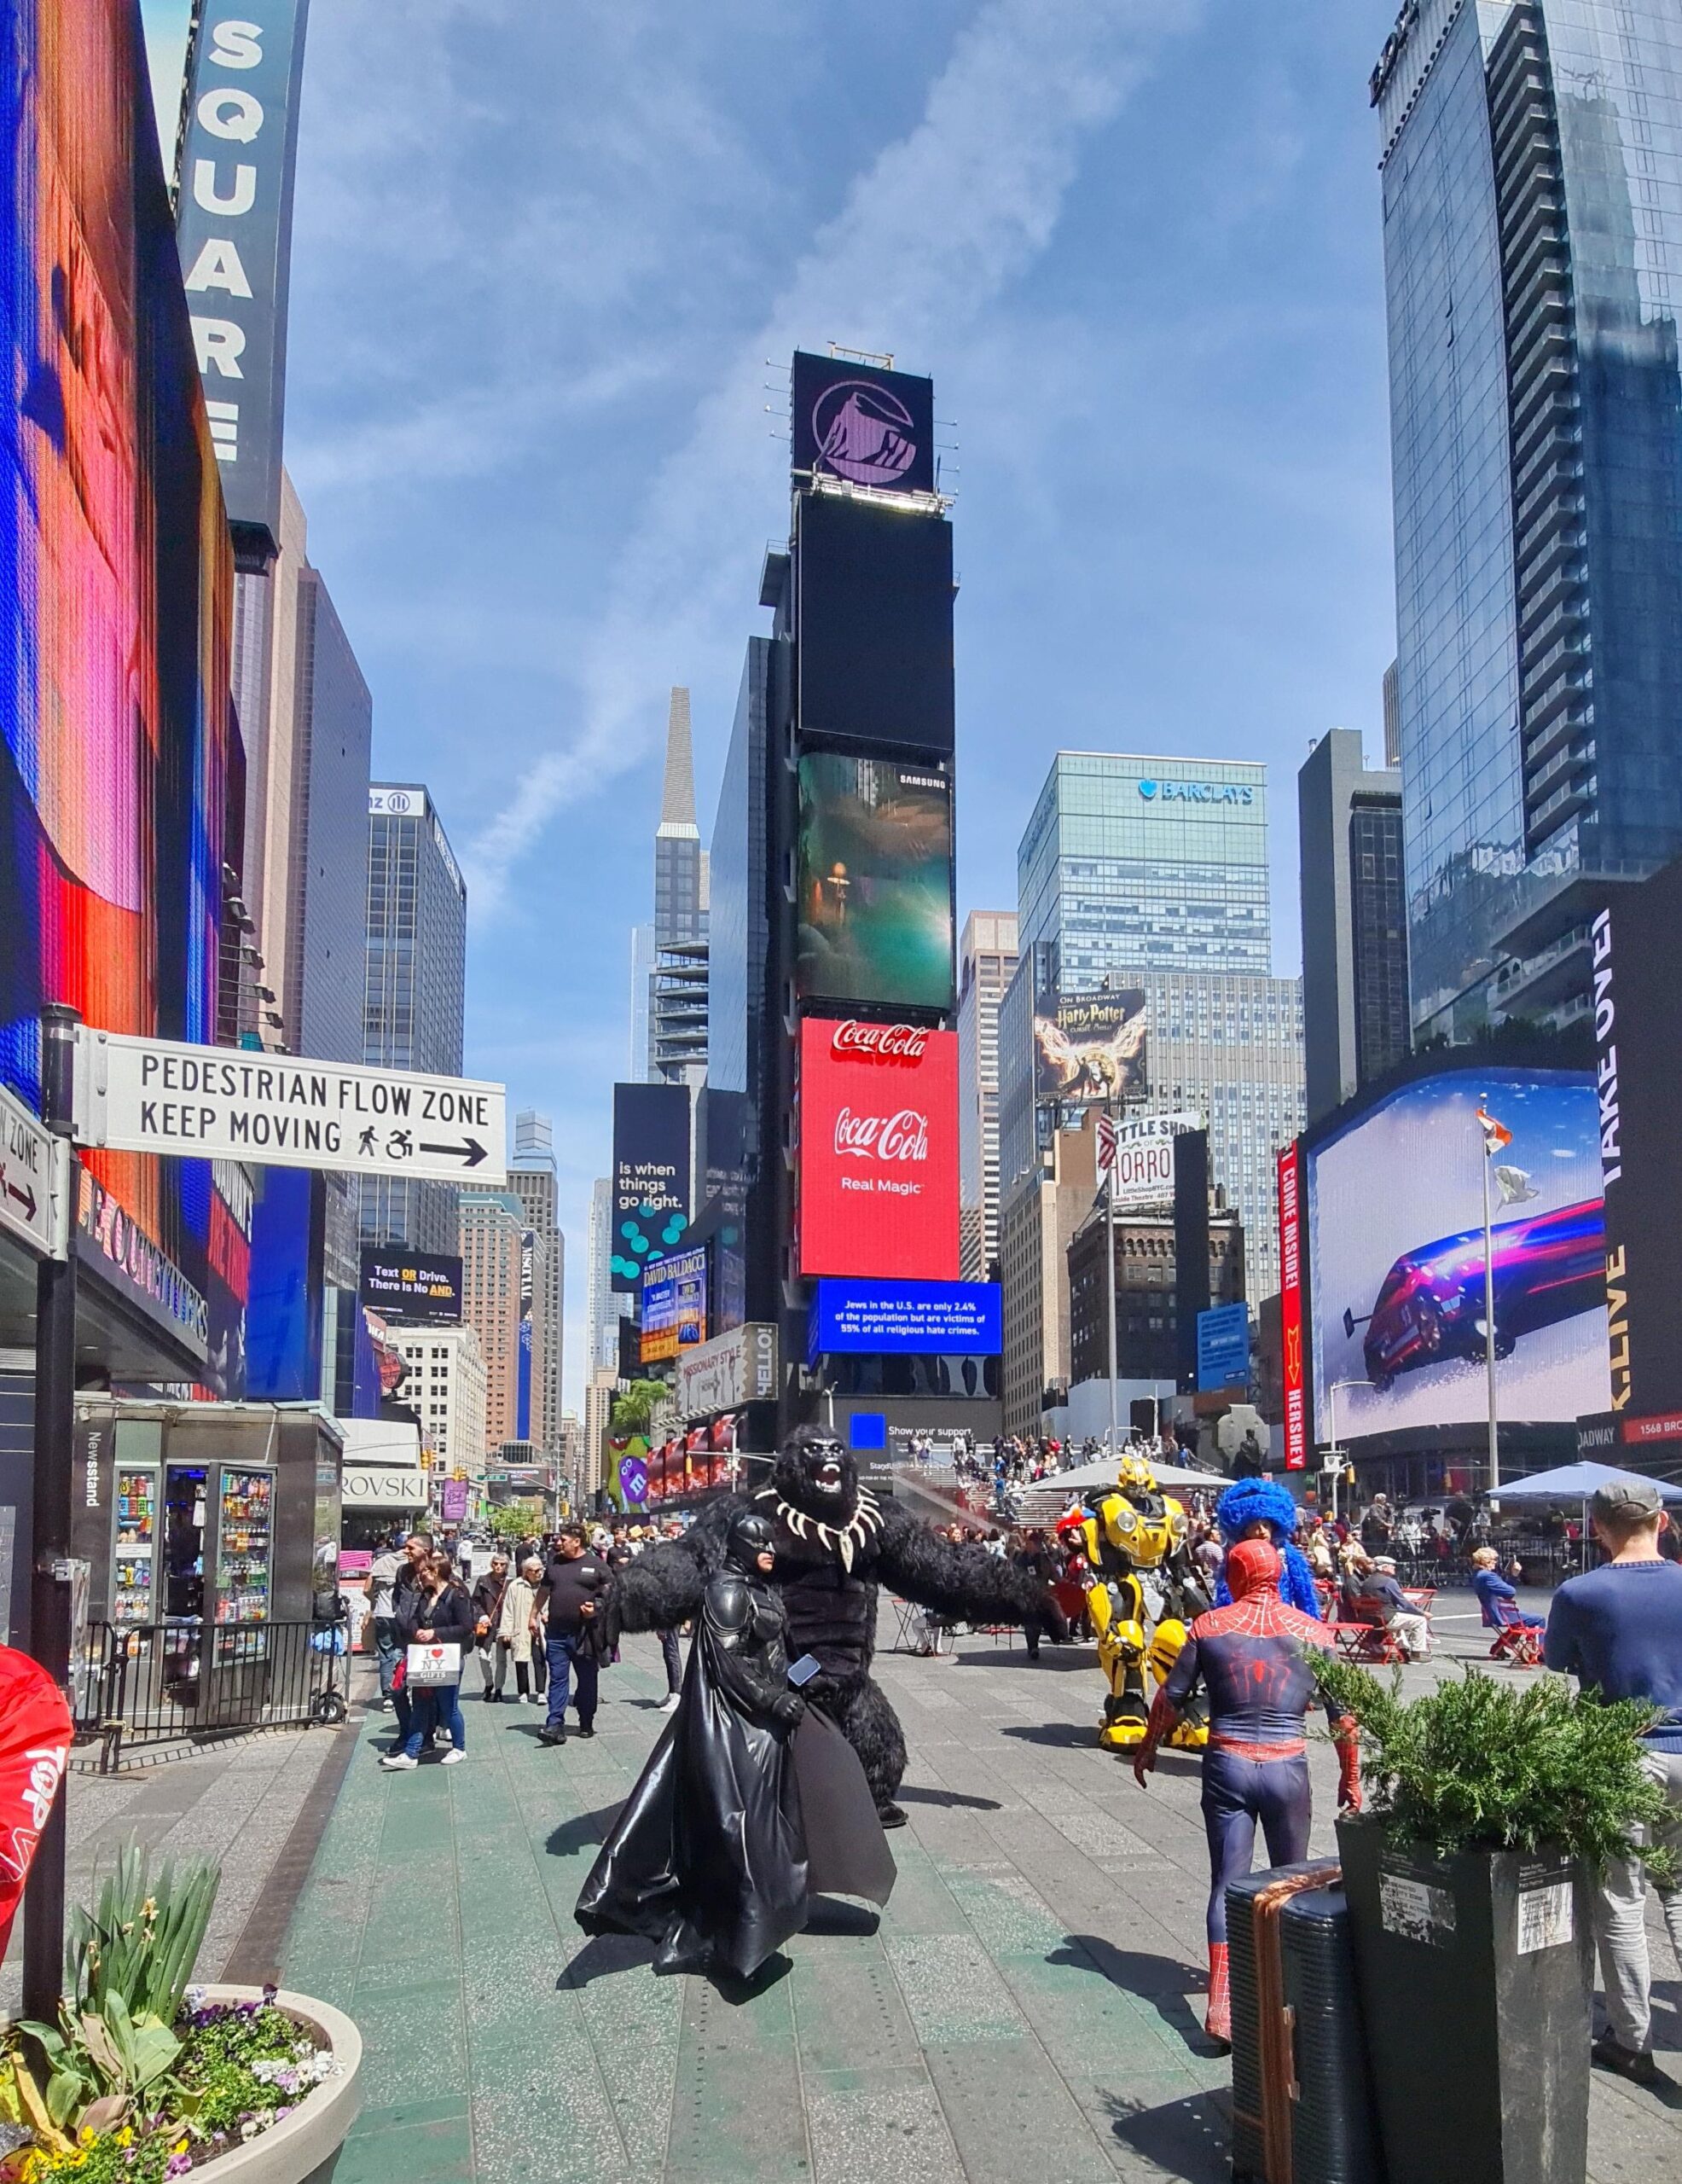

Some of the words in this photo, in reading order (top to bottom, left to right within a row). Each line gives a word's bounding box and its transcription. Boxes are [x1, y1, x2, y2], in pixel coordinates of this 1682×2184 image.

[185, 20, 264, 462] SQUARE
[900, 775, 946, 789] SAMSUNG
[1162, 781, 1254, 804] BARCLAYS
[1076, 994, 1121, 1003] BROADWAY
[1058, 1007, 1089, 1030] Harry
[1090, 1004, 1125, 1023] Potter
[832, 1019, 929, 1057] Coca-Cola
[142, 1054, 327, 1107] PEDESTRIAN
[339, 1079, 411, 1117] FLOW
[422, 1090, 489, 1126] ZONE
[141, 1101, 217, 1139] KEEP
[230, 1111, 341, 1153] MOVING
[834, 1107, 928, 1160] Coca-Cola
[10, 1115, 38, 1175] ZONE
[618, 1161, 631, 1175] is
[635, 1162, 676, 1176] when
[618, 1177, 666, 1194] things
[841, 1176, 874, 1192] Real
[1282, 1166, 1296, 1221] COME
[618, 1196, 640, 1210] go
[642, 1194, 682, 1211] right.
[1284, 1221, 1299, 1291] INSIDE!
[374, 1265, 399, 1278] Text
[402, 1269, 417, 1281] OR
[419, 1270, 450, 1283] Drive.
[644, 1266, 667, 1287] DAVID
[667, 1252, 705, 1281] BALDACCI
[368, 1277, 400, 1291] There
[414, 1282, 428, 1293] No
[429, 1284, 455, 1298] AND.
[844, 1300, 867, 1310] Jews
[869, 1301, 879, 1310] in
[880, 1300, 895, 1310] the
[896, 1301, 915, 1310] U.S.
[933, 1302, 952, 1312] only
[954, 1302, 977, 1311] 2.4%
[835, 1312, 844, 1321] of
[846, 1312, 861, 1321] the
[862, 1313, 908, 1323] population
[910, 1314, 925, 1322] but
[943, 1314, 974, 1323] victims
[977, 1315, 985, 1323] of
[840, 1324, 860, 1333] 55%
[862, 1324, 872, 1333] of
[873, 1325, 884, 1333] all
[886, 1326, 925, 1336] religious
[926, 1326, 945, 1334] hate
[948, 1327, 980, 1335] crimes.
[720, 1345, 741, 1365] STYLE
[757, 1327, 773, 1396] HELLO!
[888, 1426, 913, 1436] Show
[914, 1428, 936, 1438] your
[1288, 1389, 1303, 1467] HERSHEY
[1640, 1422, 1662, 1435] 1568
[86, 1432, 102, 1507] Newsstand
[421, 1658, 446, 1670] NY
[424, 1649, 431, 1659] I
